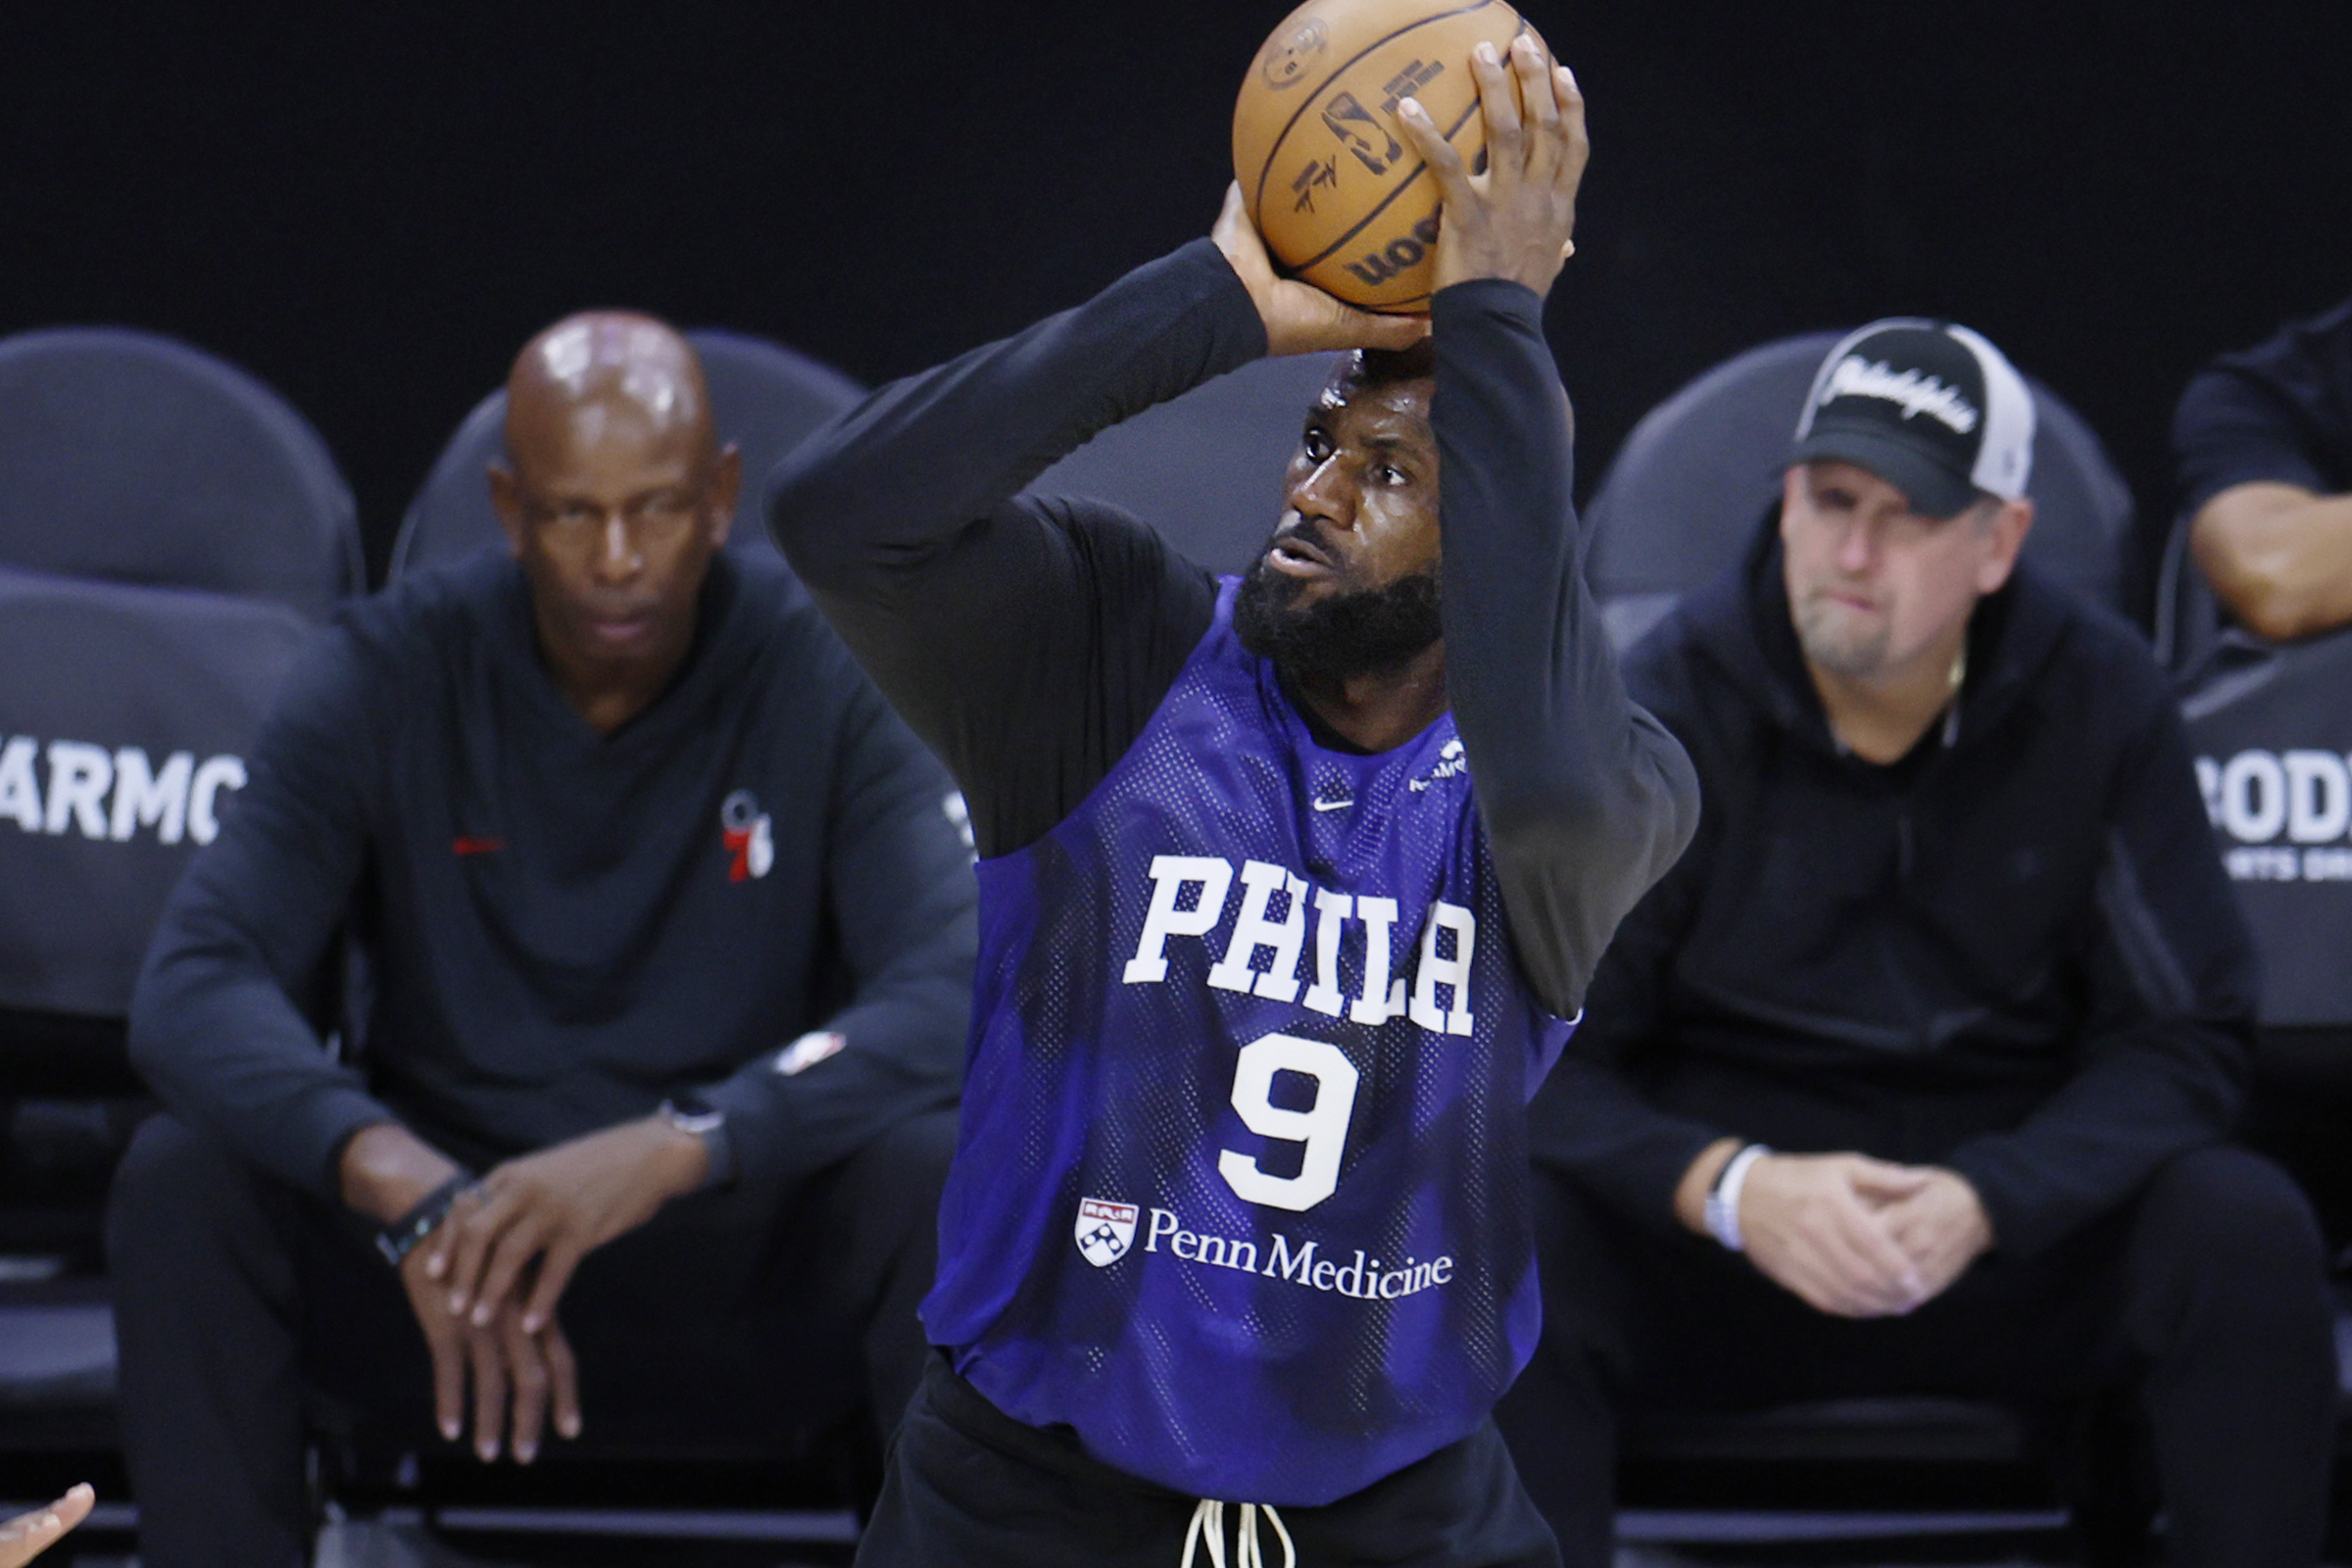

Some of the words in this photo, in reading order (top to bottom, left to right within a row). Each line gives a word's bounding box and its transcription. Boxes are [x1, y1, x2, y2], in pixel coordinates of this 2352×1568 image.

[1122, 855, 1477, 1038] PHILA
[1217, 1032, 1360, 1212] 9
[1144, 1206, 1258, 1274] Penn
[1260, 1232, 1454, 1301] Medicine
